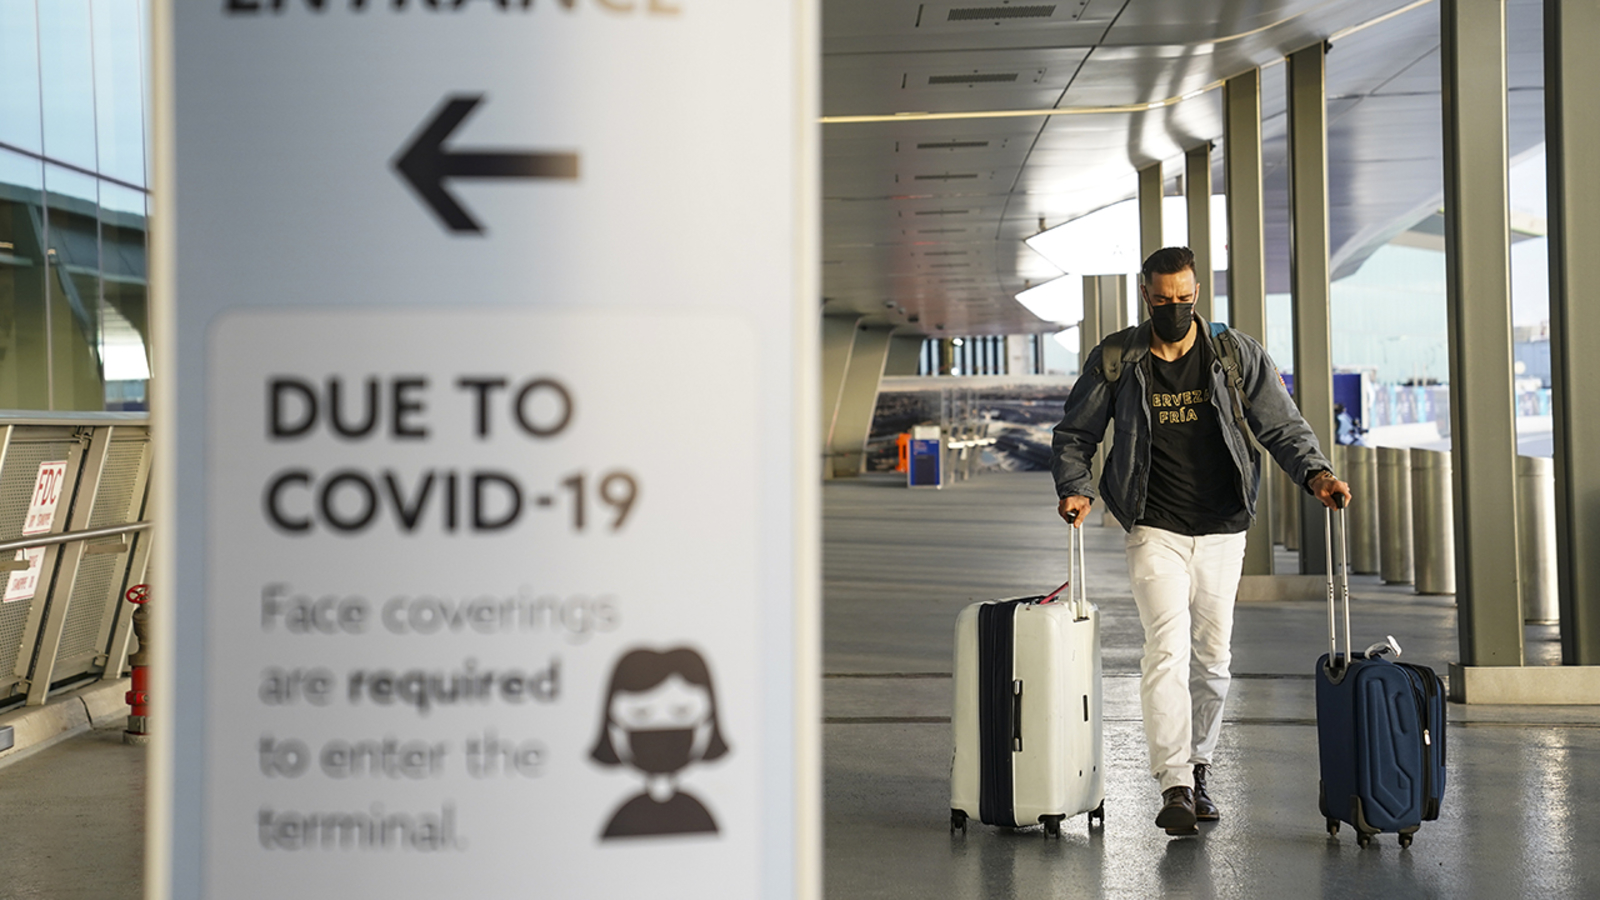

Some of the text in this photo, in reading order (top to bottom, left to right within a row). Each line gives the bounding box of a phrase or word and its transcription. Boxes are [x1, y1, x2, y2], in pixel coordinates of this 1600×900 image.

[266, 375, 575, 441] DUE TO
[1159, 406, 1198, 424] FRÍA
[33, 468, 63, 507] FDC
[263, 468, 641, 536] COVID-19
[260, 582, 622, 645] Face coverings
[258, 656, 562, 715] are required
[257, 730, 548, 779] to enter the
[257, 802, 467, 852] terminal.
